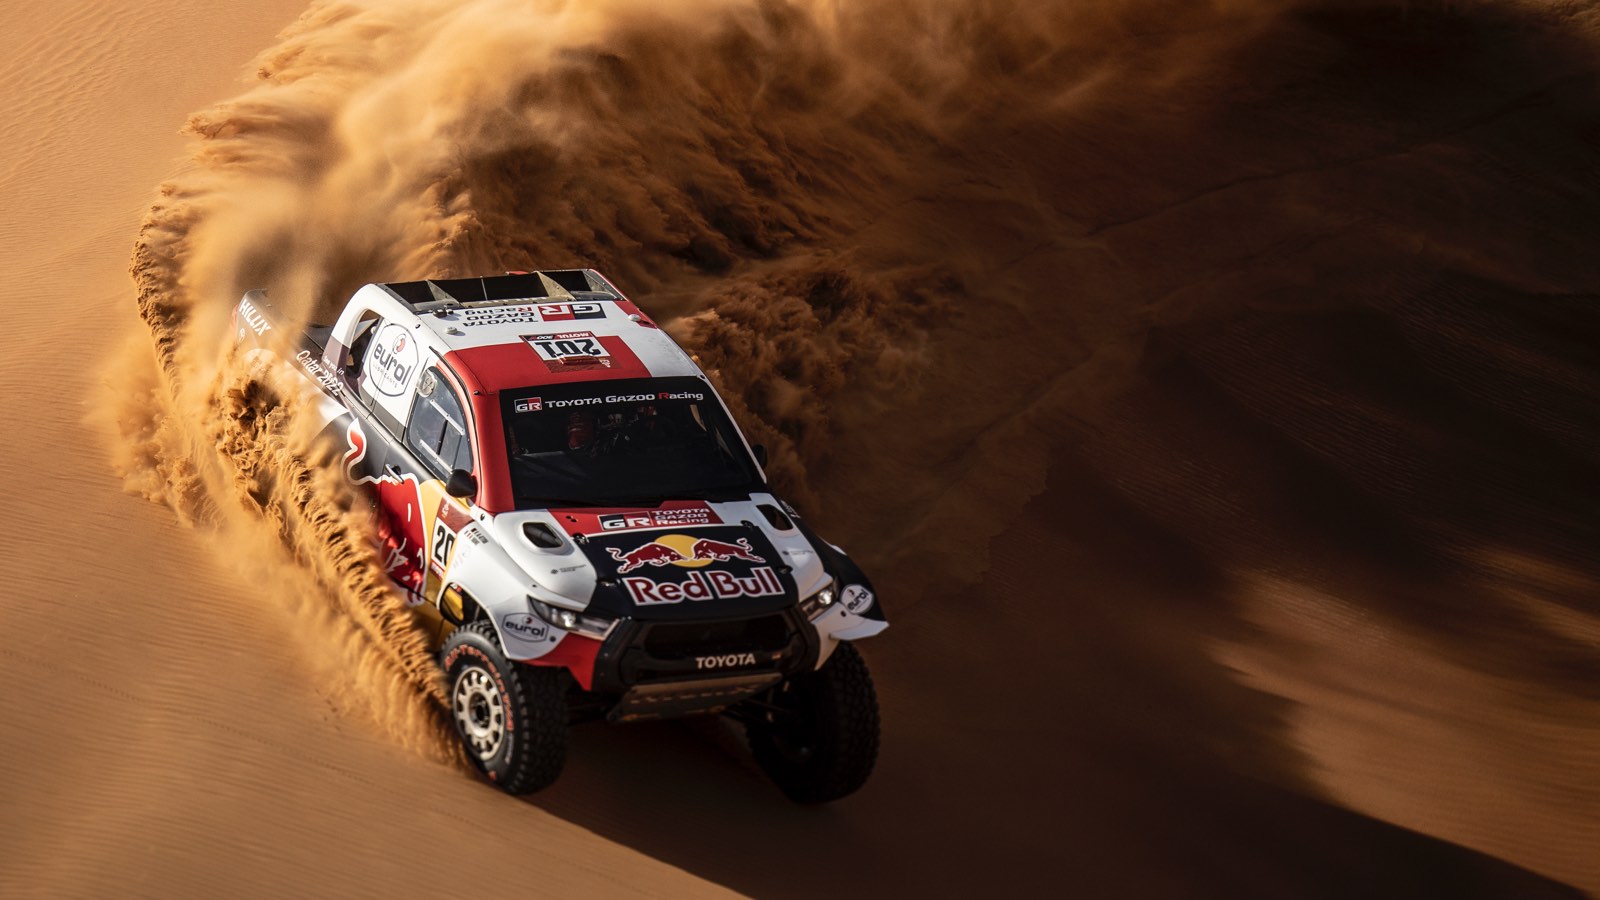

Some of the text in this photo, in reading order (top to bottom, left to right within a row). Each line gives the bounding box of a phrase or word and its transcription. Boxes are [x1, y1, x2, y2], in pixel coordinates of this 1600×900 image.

[239, 298, 271, 337] HILUX
[465, 307, 532, 315] Racing
[467, 312, 534, 320] GAZOO
[539, 303, 602, 316] GR
[462, 317, 538, 327] TOYOTA
[534, 338, 602, 359] 201
[337, 367, 345, 376] in
[374, 343, 412, 386] eurol
[296, 350, 344, 396] Qatar 2022
[516, 391, 704, 412] GR TOYOTA GAZOO Racing
[652, 508, 710, 516] TOYOTA
[602, 516, 651, 530] GR
[656, 518, 709, 526] Racing
[622, 566, 786, 606] Red Bull
[847, 588, 869, 610] eurol
[504, 620, 545, 638] eurol
[695, 653, 756, 669] TOYOTA
